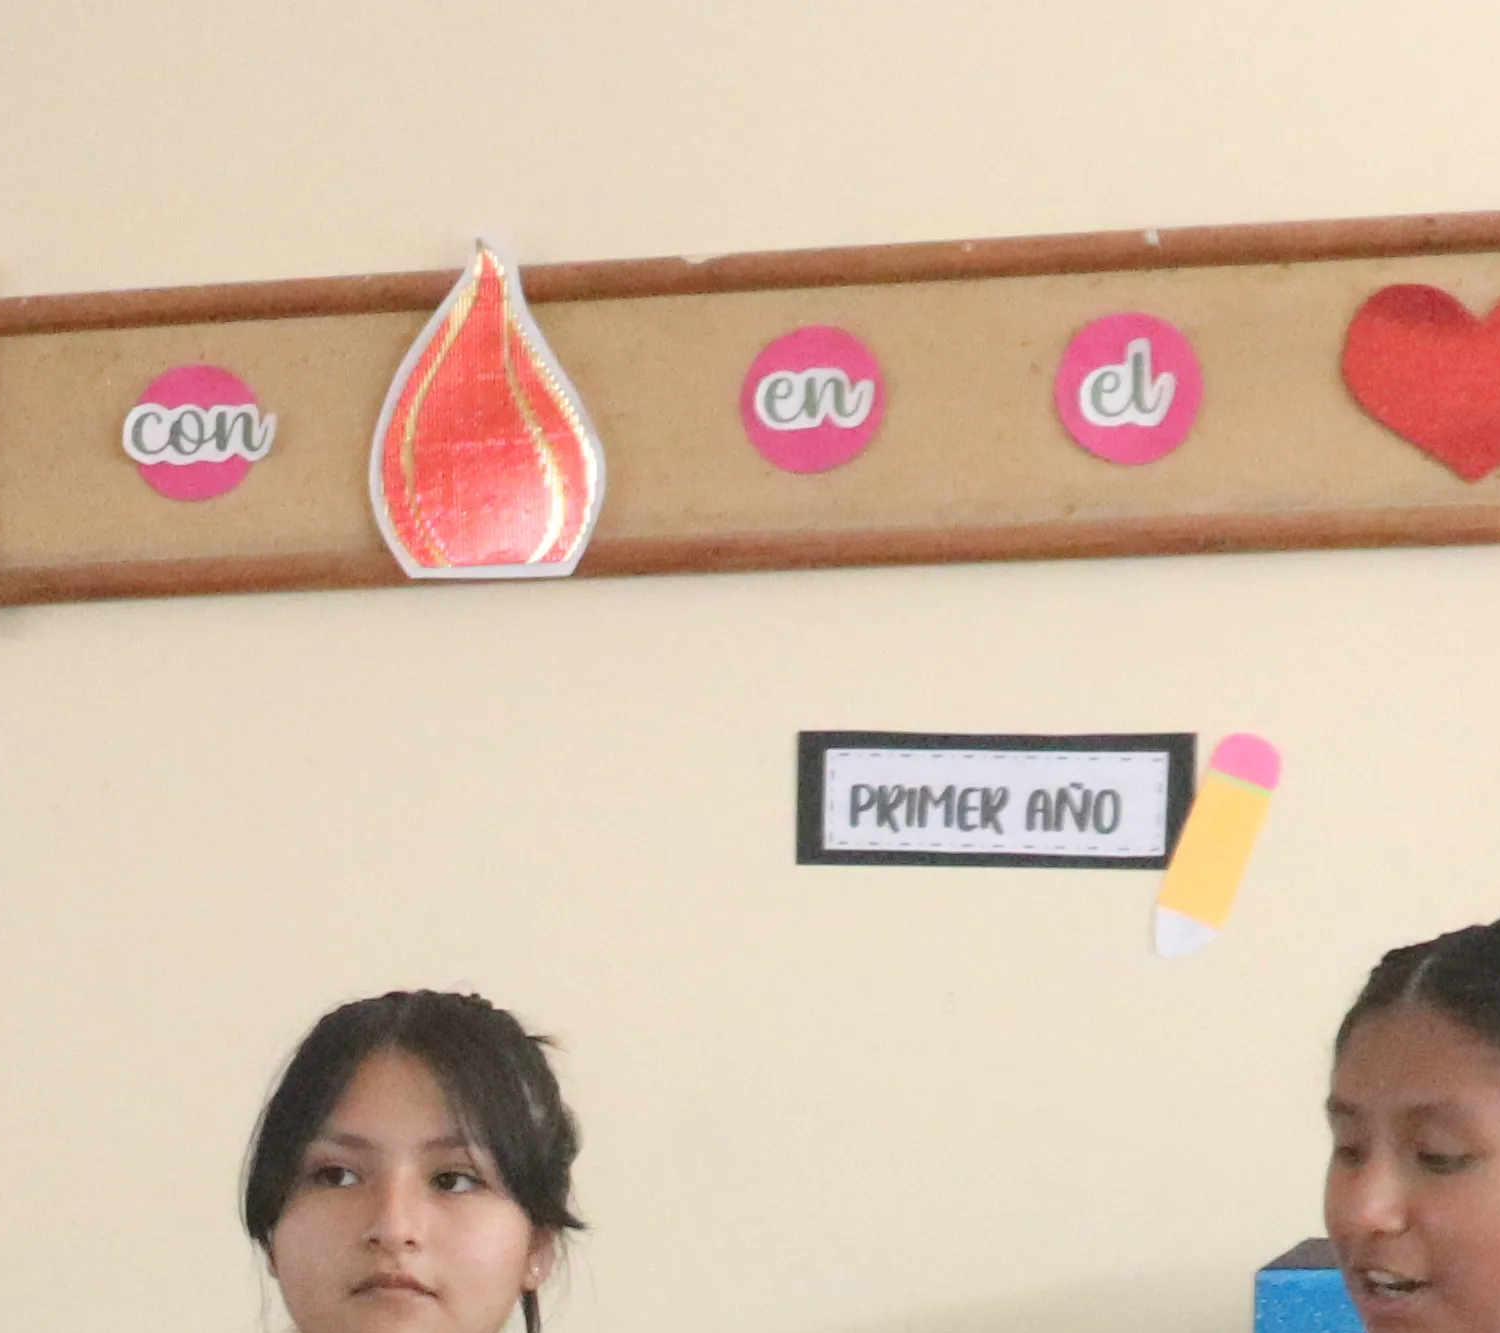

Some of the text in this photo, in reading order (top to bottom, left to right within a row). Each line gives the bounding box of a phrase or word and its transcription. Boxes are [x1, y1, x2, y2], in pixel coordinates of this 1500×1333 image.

[129, 346, 1172, 456] con en el
[849, 782, 1123, 836] PRIMER AÑO
